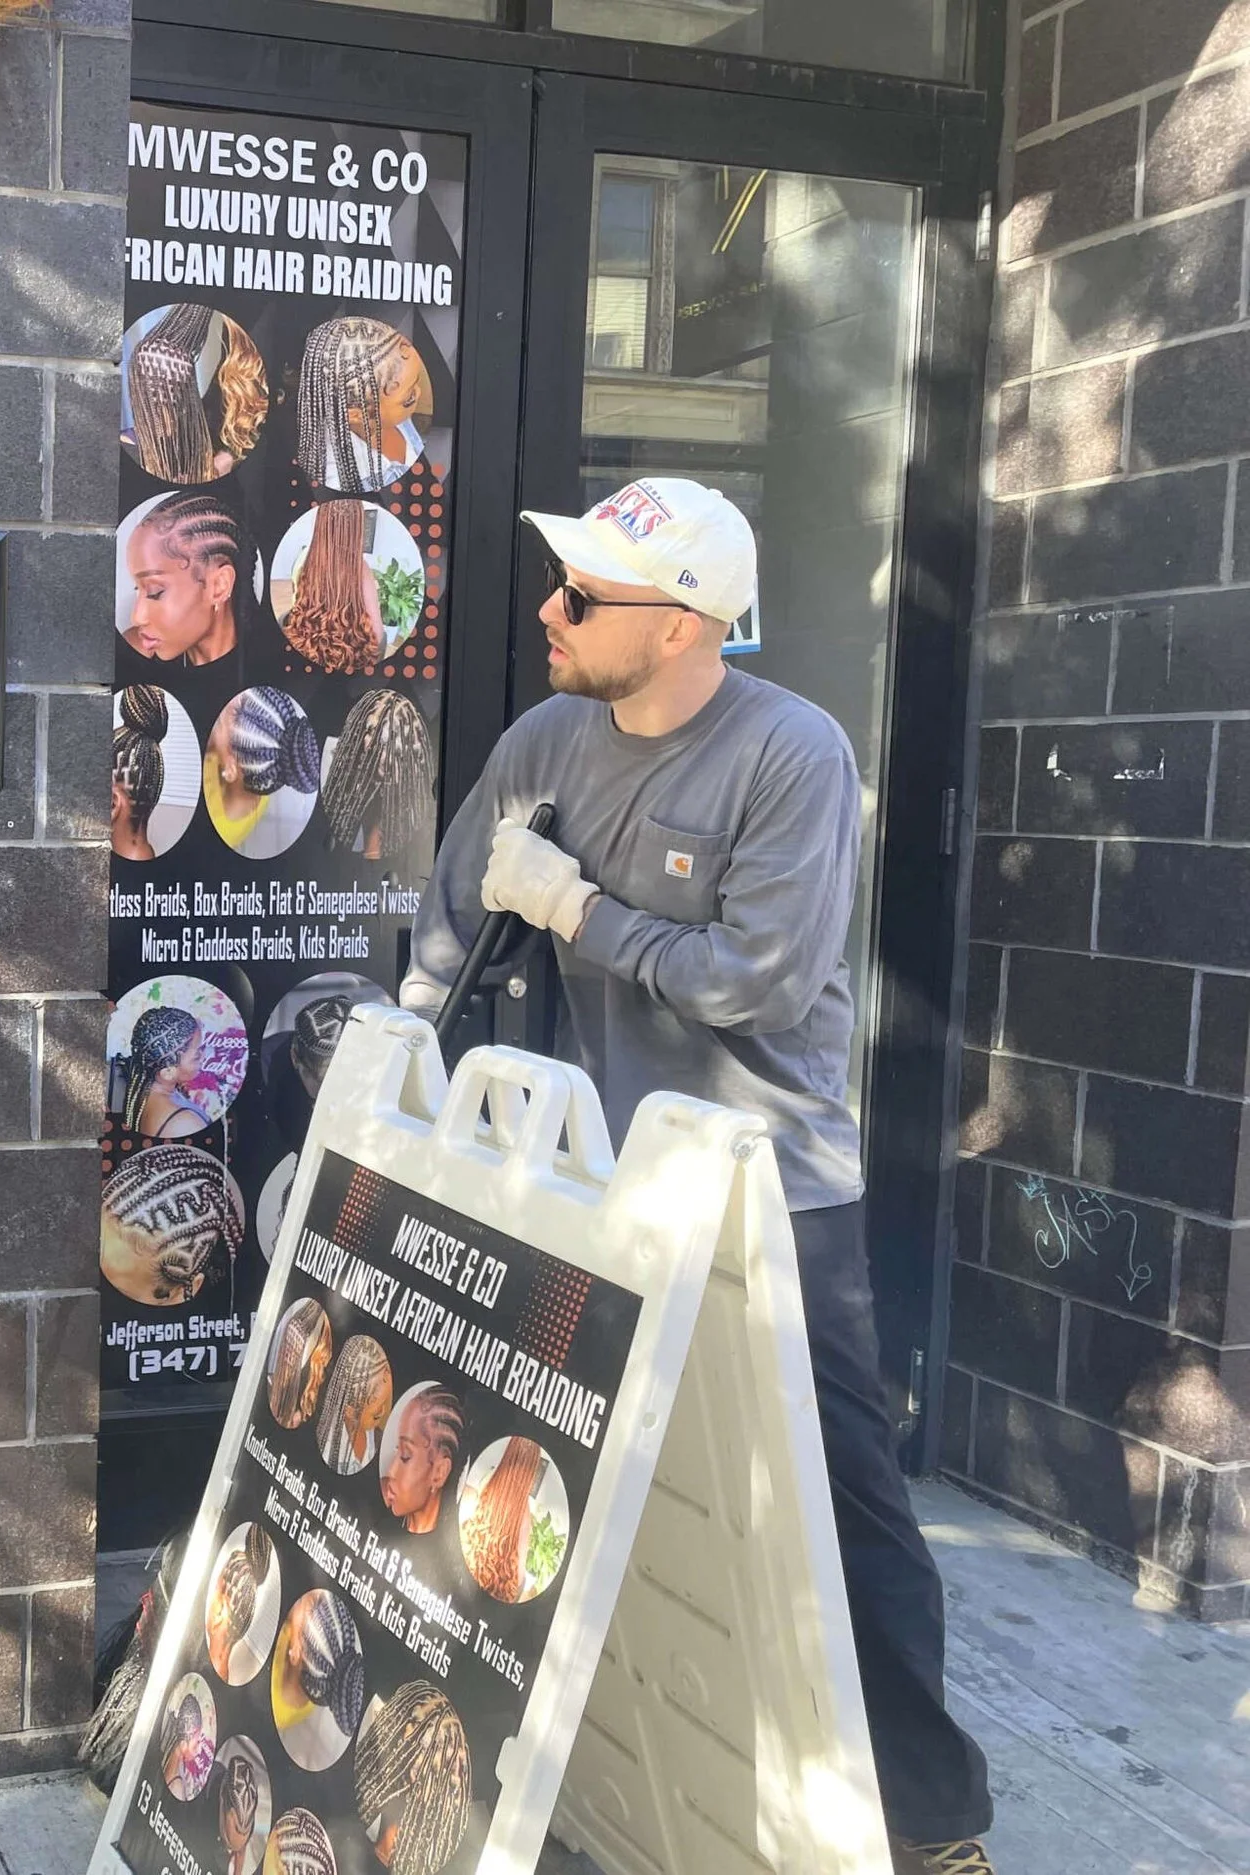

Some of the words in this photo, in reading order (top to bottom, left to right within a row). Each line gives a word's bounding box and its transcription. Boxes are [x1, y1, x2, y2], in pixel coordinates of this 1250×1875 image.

[128, 122, 317, 184] MWESSE
[327, 144, 359, 189] &
[372, 148, 428, 195] CO
[165, 184, 281, 237] LUXURY
[287, 196, 392, 247] UNISEX
[233, 247, 305, 294] HAIR
[312, 253, 453, 306] BRAIDING
[109, 883, 141, 917] tless
[145, 882, 191, 920] Braids,
[194, 882, 218, 916] Box
[221, 881, 266, 918] Braids,
[269, 881, 292, 915] Flat
[296, 881, 305, 915] &
[308, 880, 377, 922] Senegalese
[381, 881, 420, 914] Twists
[142, 928, 178, 962] Micro
[182, 927, 191, 962] &
[195, 927, 248, 961] Goddess
[252, 926, 295, 962] Braids,
[299, 925, 325, 959] Kids
[329, 925, 369, 959] Braids
[390, 1214, 466, 1285] MWESSE
[457, 1248, 479, 1294] &
[472, 1256, 507, 1309] CO
[107, 1320, 184, 1351] Jefferson
[189, 1313, 245, 1339] Street,
[295, 1228, 350, 1292] LUXURY
[341, 1255, 400, 1325] UNISEX
[390, 1287, 466, 1364] AFRICAN
[458, 1324, 510, 1391] HAIR
[502, 1350, 607, 1449] BRAIDING
[128, 1346, 217, 1381] (347)
[244, 1423, 277, 1475] Knotless
[275, 1453, 306, 1506] Braids,
[306, 1481, 327, 1521] Box
[325, 1498, 361, 1556] Braids,
[362, 1530, 387, 1574] Flat
[385, 1549, 399, 1583] &
[396, 1558, 472, 1644] Senegalese
[474, 1618, 525, 1691] Twists,
[264, 1486, 291, 1532] Micro
[289, 1509, 301, 1539] &
[298, 1518, 339, 1579] Goddess
[338, 1555, 377, 1618] Braids,
[378, 1591, 406, 1639] Kids
[405, 1615, 451, 1678] Braids
[137, 1779, 153, 1815] 13
